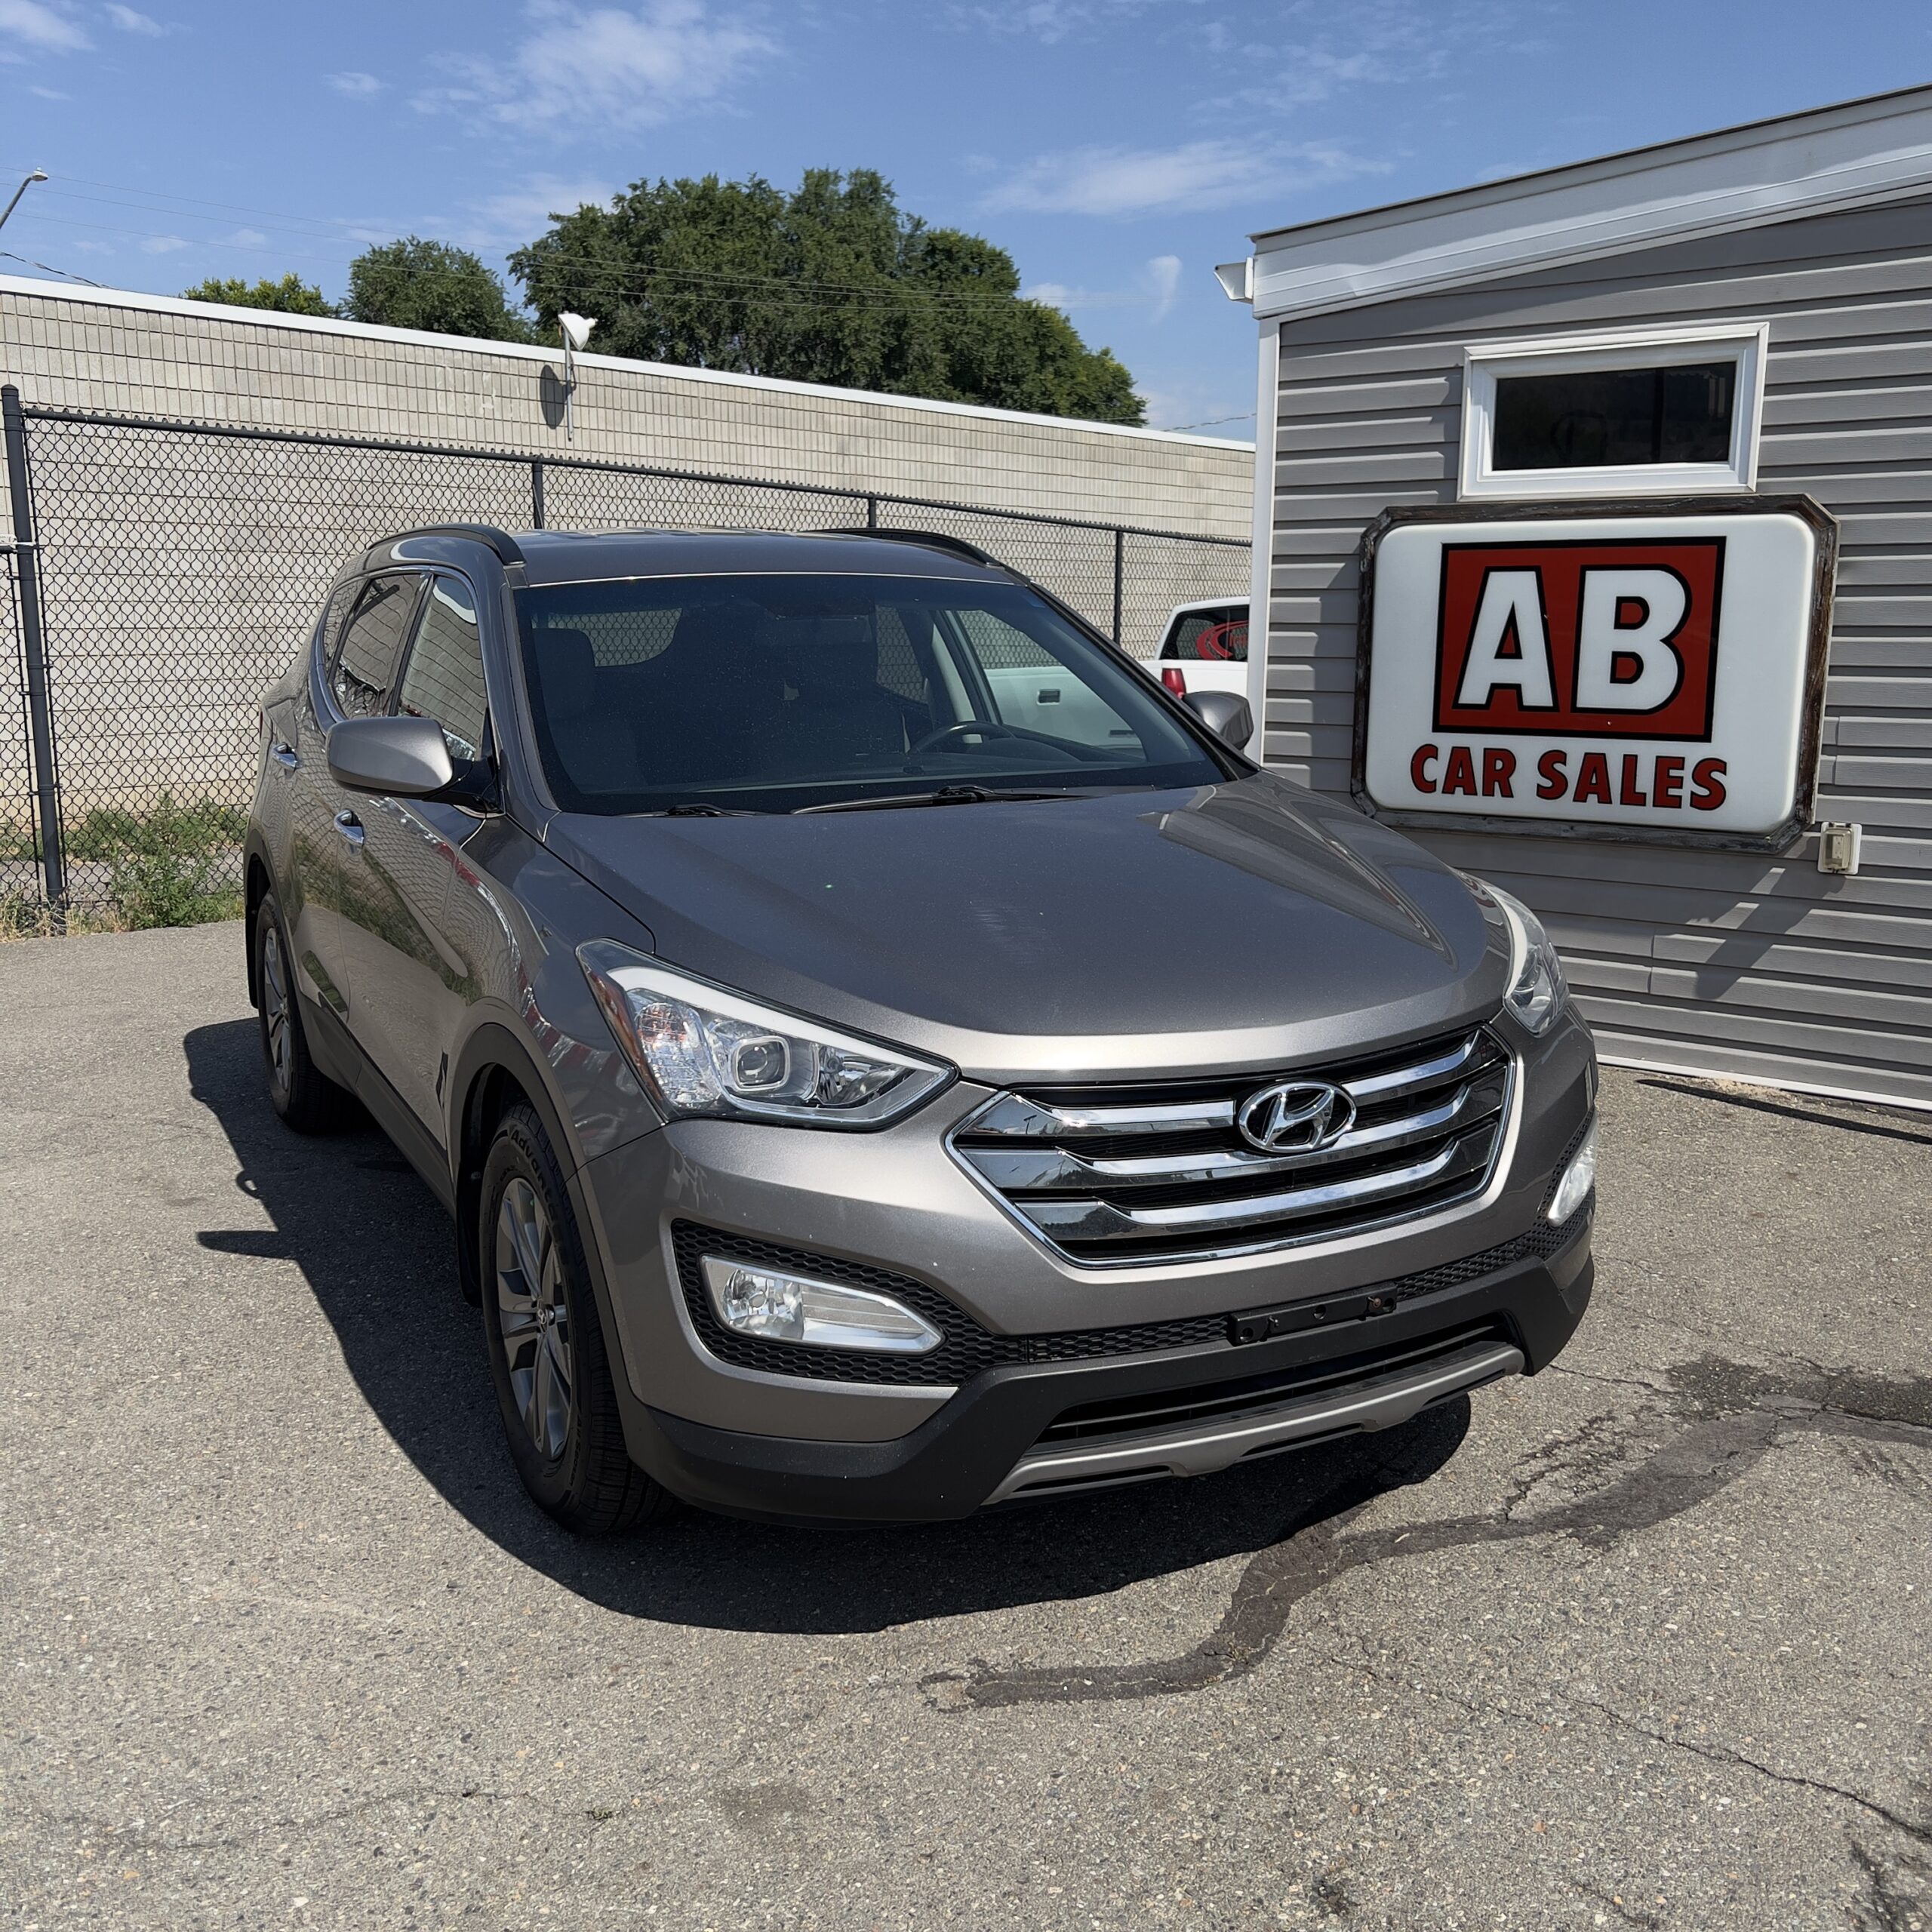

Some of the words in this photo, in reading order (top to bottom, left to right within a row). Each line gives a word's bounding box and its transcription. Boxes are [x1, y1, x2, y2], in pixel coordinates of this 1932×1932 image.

[1451, 564, 1692, 716] AB
[1410, 743, 1517, 798] CAR
[1536, 749, 1727, 811] SALES
